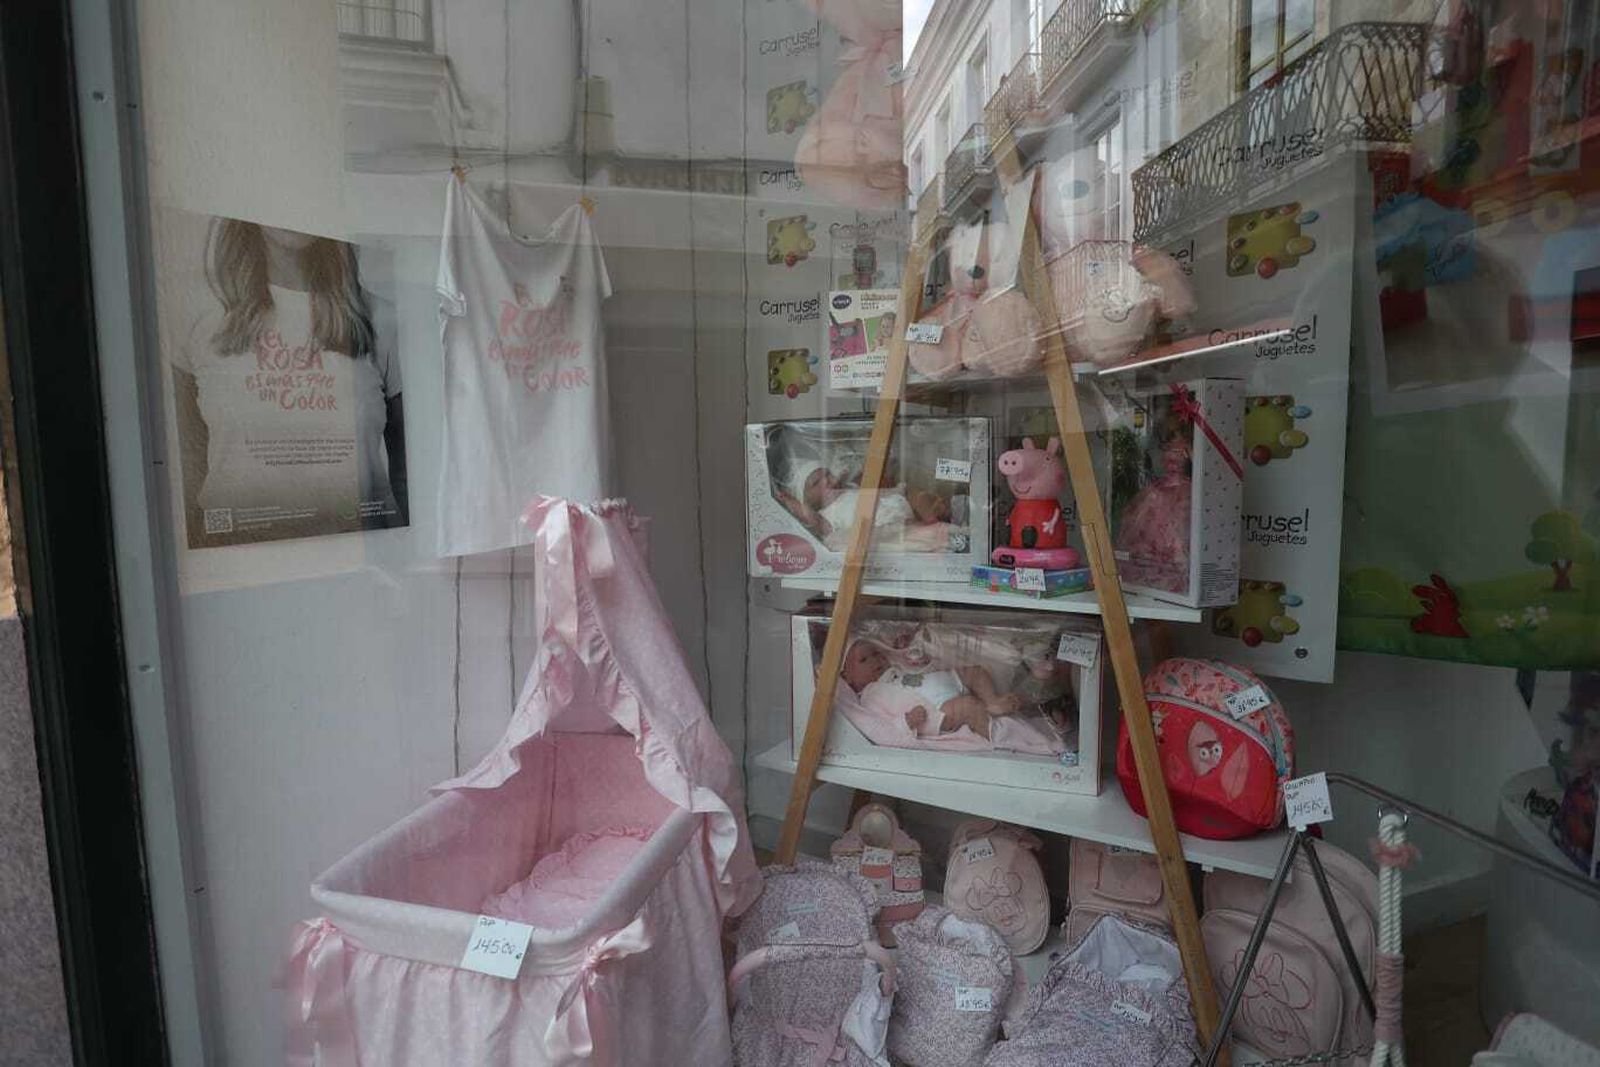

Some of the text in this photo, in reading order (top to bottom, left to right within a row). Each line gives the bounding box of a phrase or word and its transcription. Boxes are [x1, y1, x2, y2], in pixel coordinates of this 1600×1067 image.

[759, 291, 821, 316] Carrusel
[1207, 314, 1318, 347] Carrusel
[1254, 343, 1316, 361] Juguetes
[1240, 507, 1310, 533] rusel
